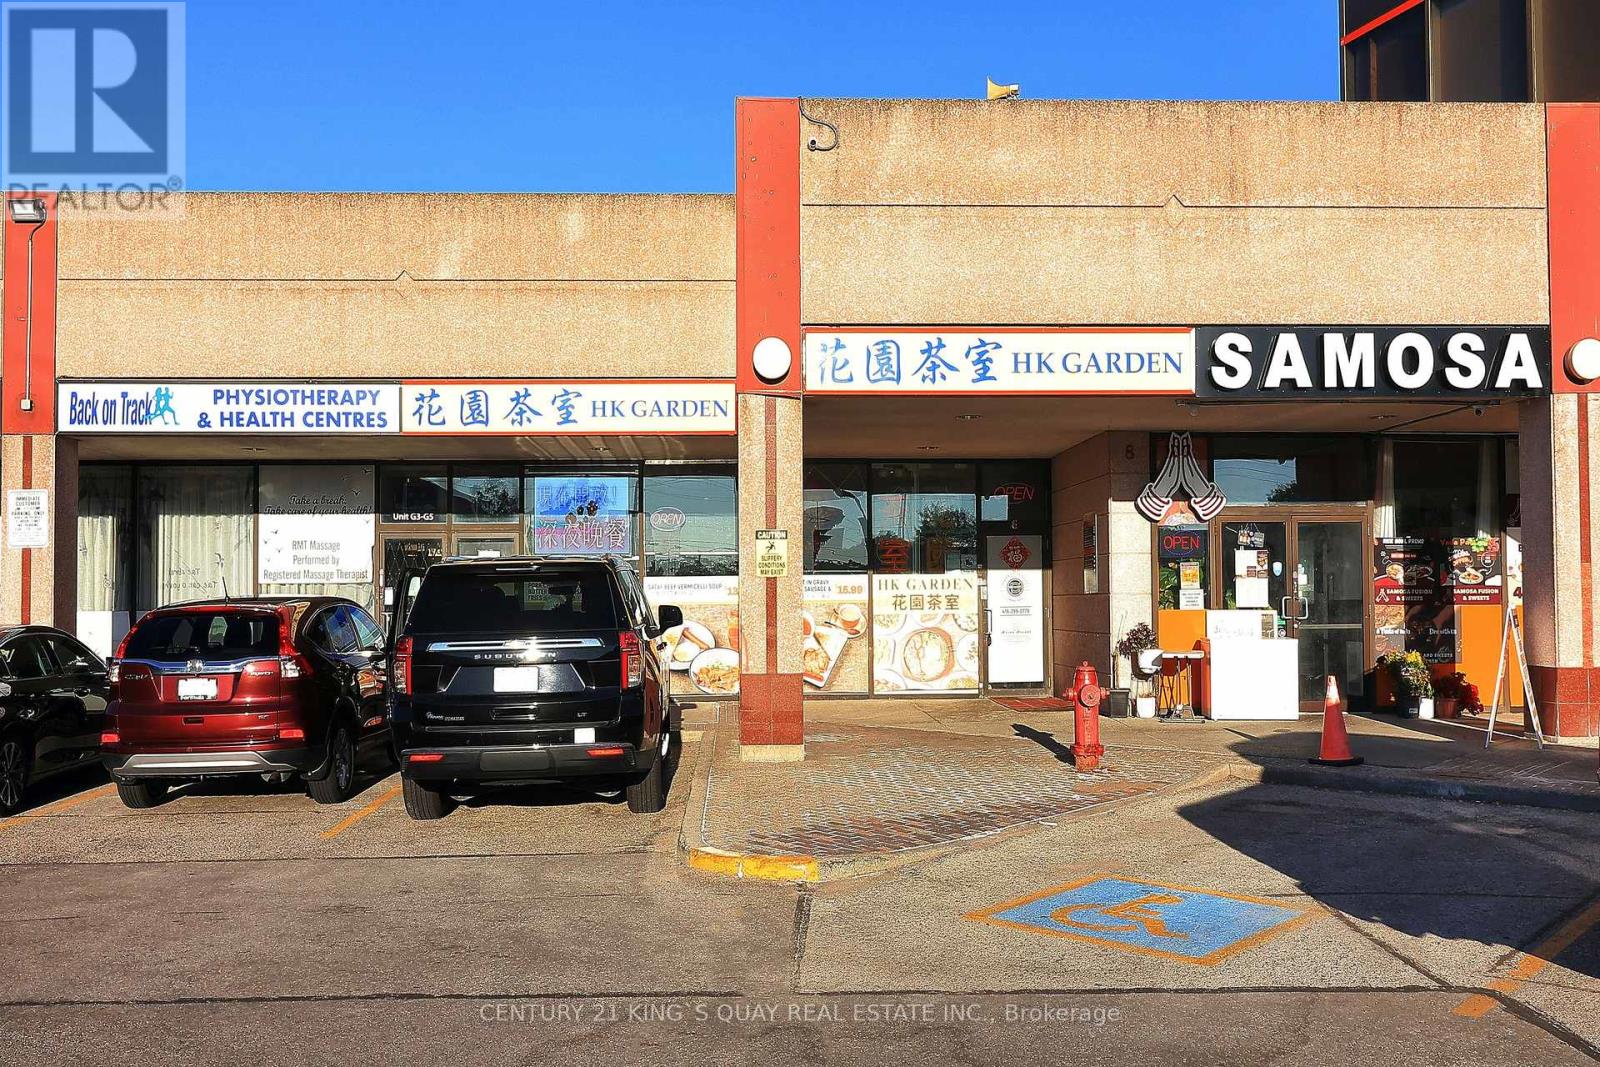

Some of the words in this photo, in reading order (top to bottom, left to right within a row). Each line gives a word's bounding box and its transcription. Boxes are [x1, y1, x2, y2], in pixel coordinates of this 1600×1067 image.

[818, 336, 1003, 386] 花園茶室
[1011, 351, 1054, 375] HK
[1062, 351, 1184, 375] GARDEN
[1211, 332, 1543, 390] SAMOSA
[213, 388, 380, 406] PHYSIOTHERAPY
[69, 391, 98, 425] Back
[102, 399, 118, 425] on
[121, 391, 152, 425] Track
[411, 387, 583, 428] 花園茶室
[591, 399, 625, 418] HK
[632, 399, 729, 418] GARDEN
[197, 411, 212, 429] &
[220, 411, 298, 428] HEALTH
[302, 411, 388, 428] CENTRES
[289, 495, 311, 505] Take
[264, 505, 286, 514] Take
[306, 506, 316, 517] of
[652, 513, 682, 525] OPEN
[757, 530, 786, 539] CAUTION
[292, 540, 308, 550] RMT
[310, 540, 341, 552] Massage
[1164, 535, 1200, 549] OPEN
[293, 555, 330, 565] Performed
[332, 555, 340, 567] by
[263, 569, 301, 581] Registered
[303, 569, 334, 581] Massage
[336, 569, 368, 581] Therapist
[878, 579, 900, 590] HK
[906, 578, 973, 590] GARDEN
[892, 593, 960, 610] 花園茶室
[474, 652, 557, 660] SUBURN
